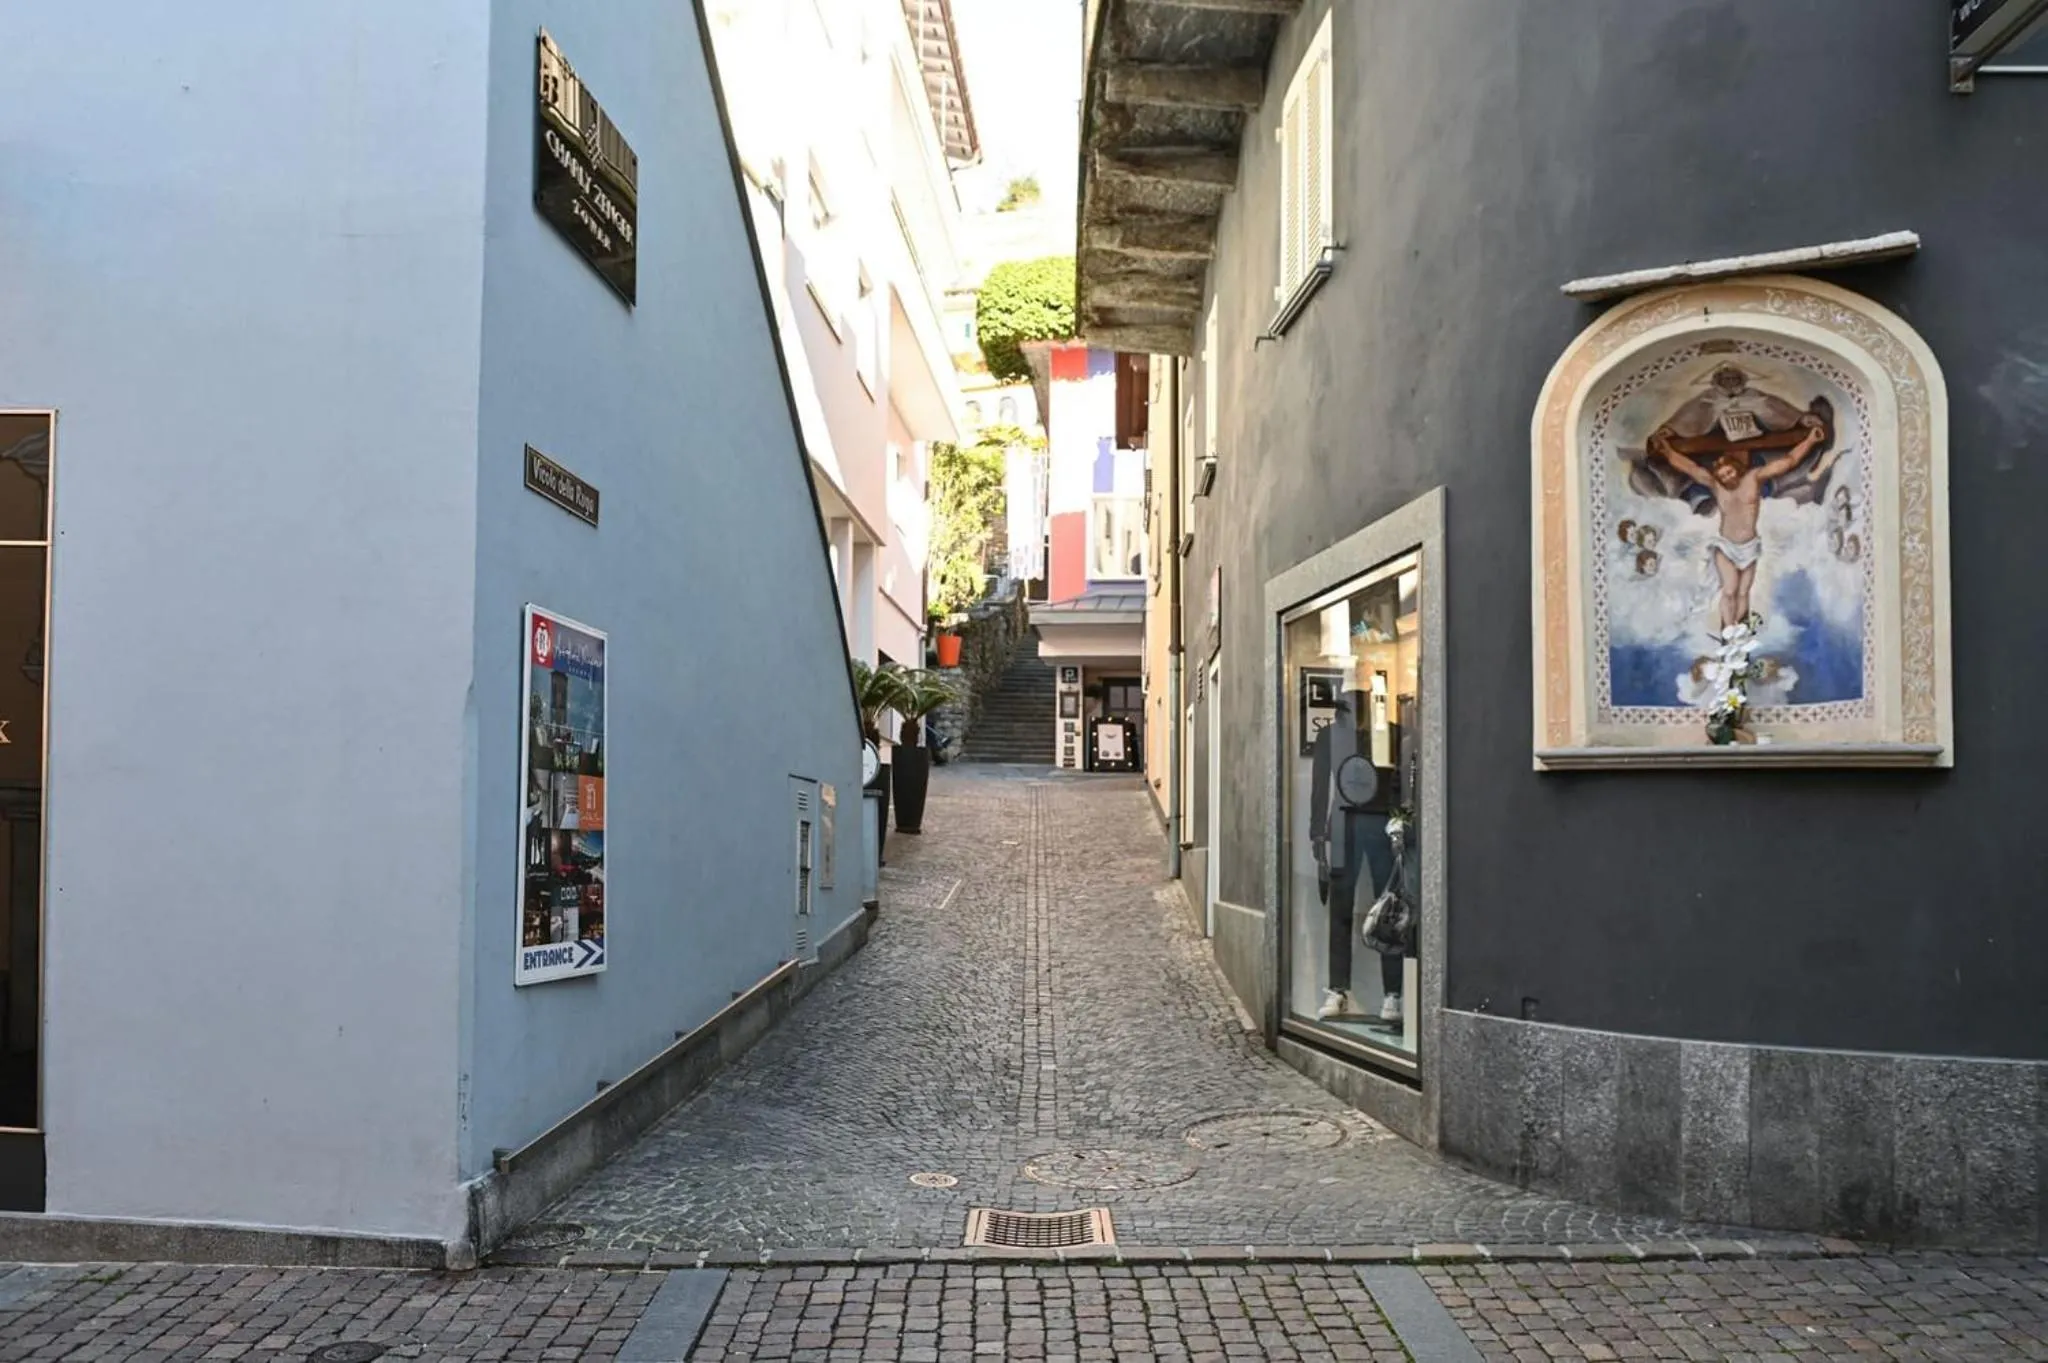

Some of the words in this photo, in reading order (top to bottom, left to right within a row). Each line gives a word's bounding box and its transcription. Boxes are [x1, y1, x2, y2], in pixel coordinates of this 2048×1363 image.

[572, 198, 612, 252] TOWER
[592, 183, 634, 247] ZENGER
[533, 456, 556, 491] Vicolo
[558, 477, 574, 502] della
[523, 946, 574, 971] ENTRANCE
